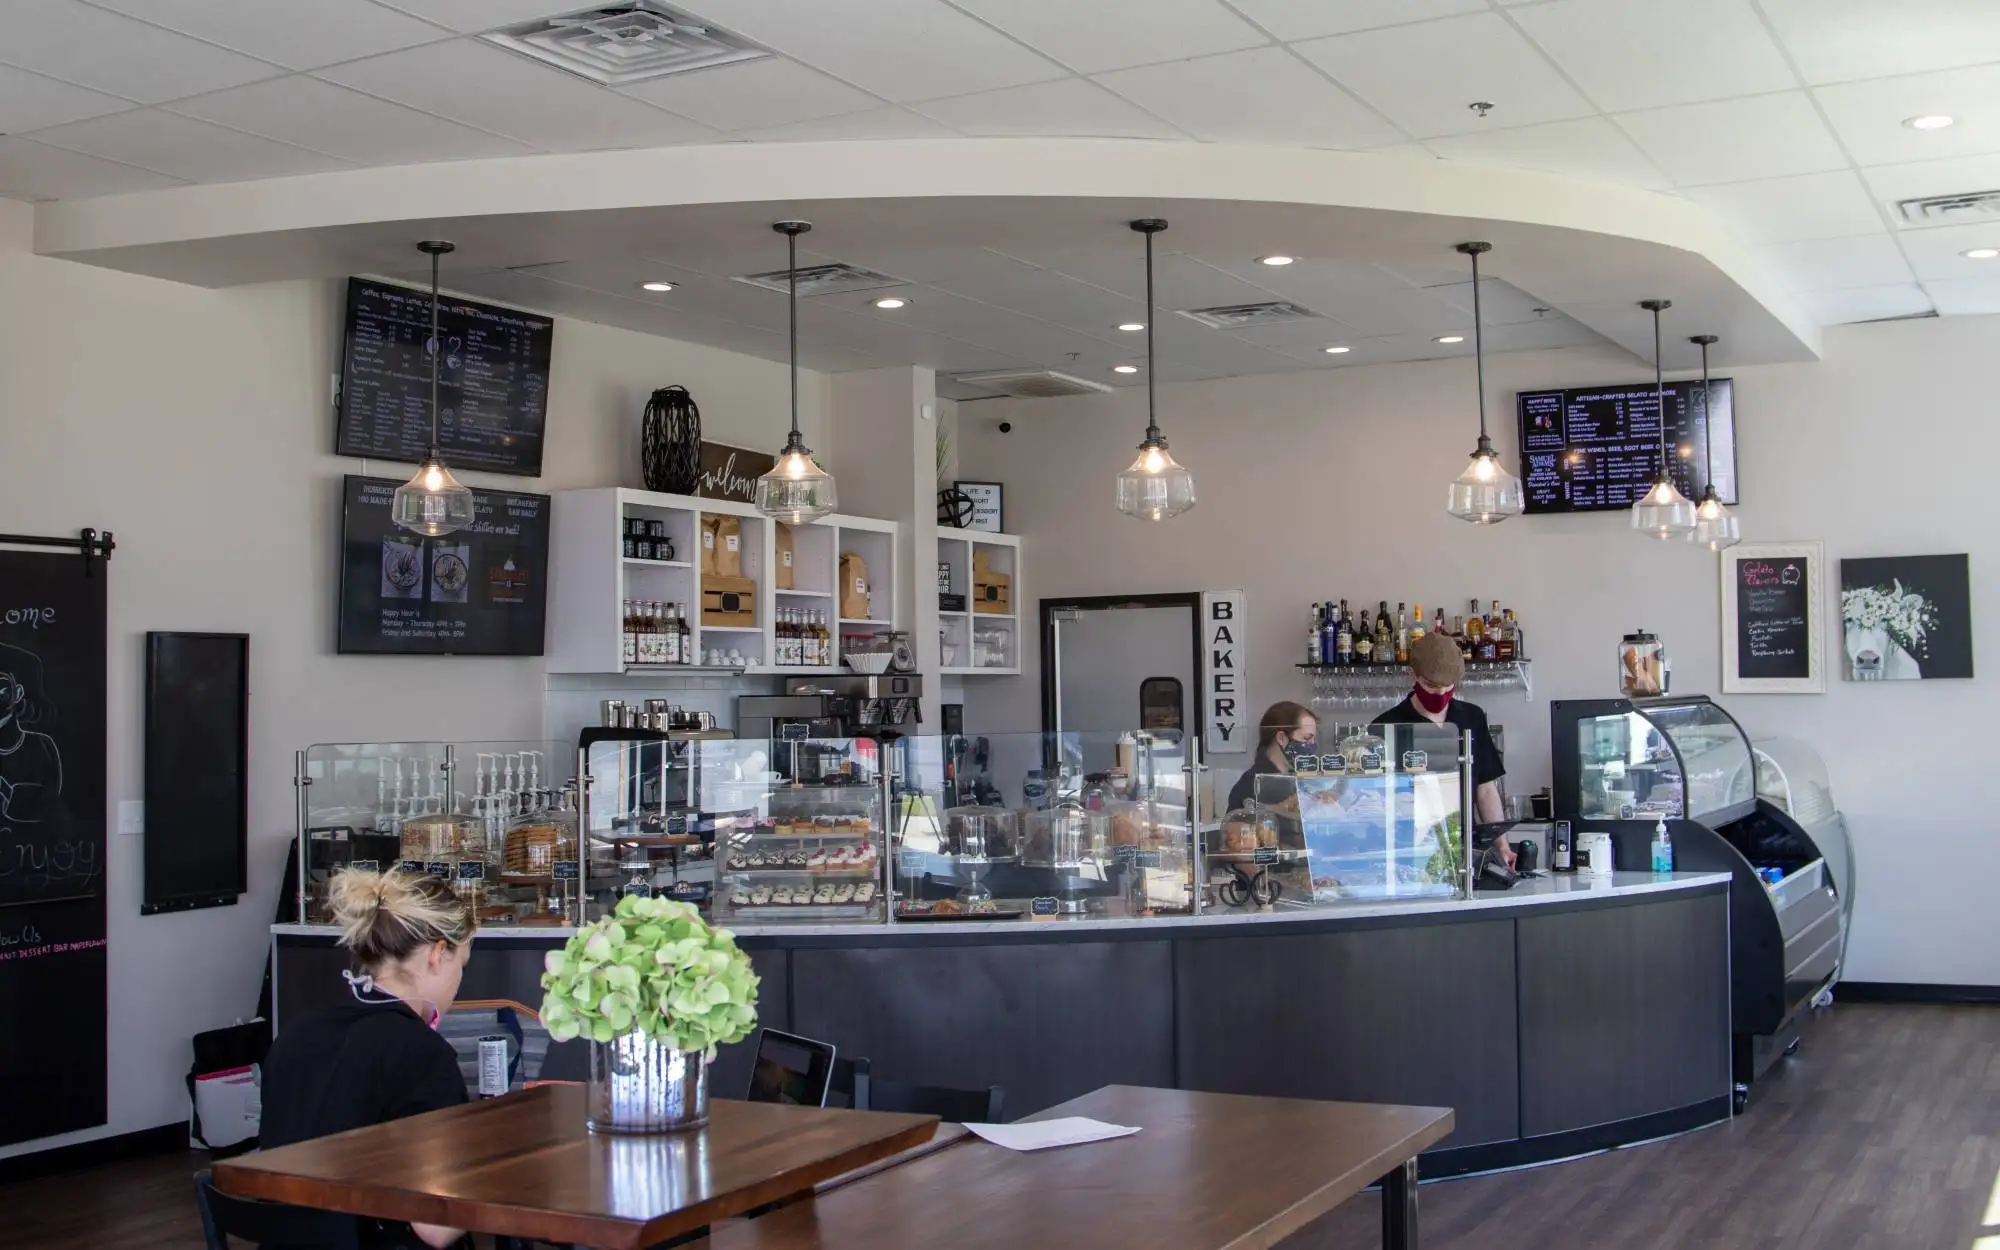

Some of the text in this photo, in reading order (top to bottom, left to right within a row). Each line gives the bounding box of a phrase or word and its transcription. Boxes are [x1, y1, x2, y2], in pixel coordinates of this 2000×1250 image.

[1530, 454, 1556, 463] SAMUEL
[0, 606, 56, 629] ome
[382, 609, 399, 618] Happy
[1212, 601, 1235, 741] BAKERY
[18, 944, 52, 958] DESSERT
[53, 942, 69, 952] BAR
